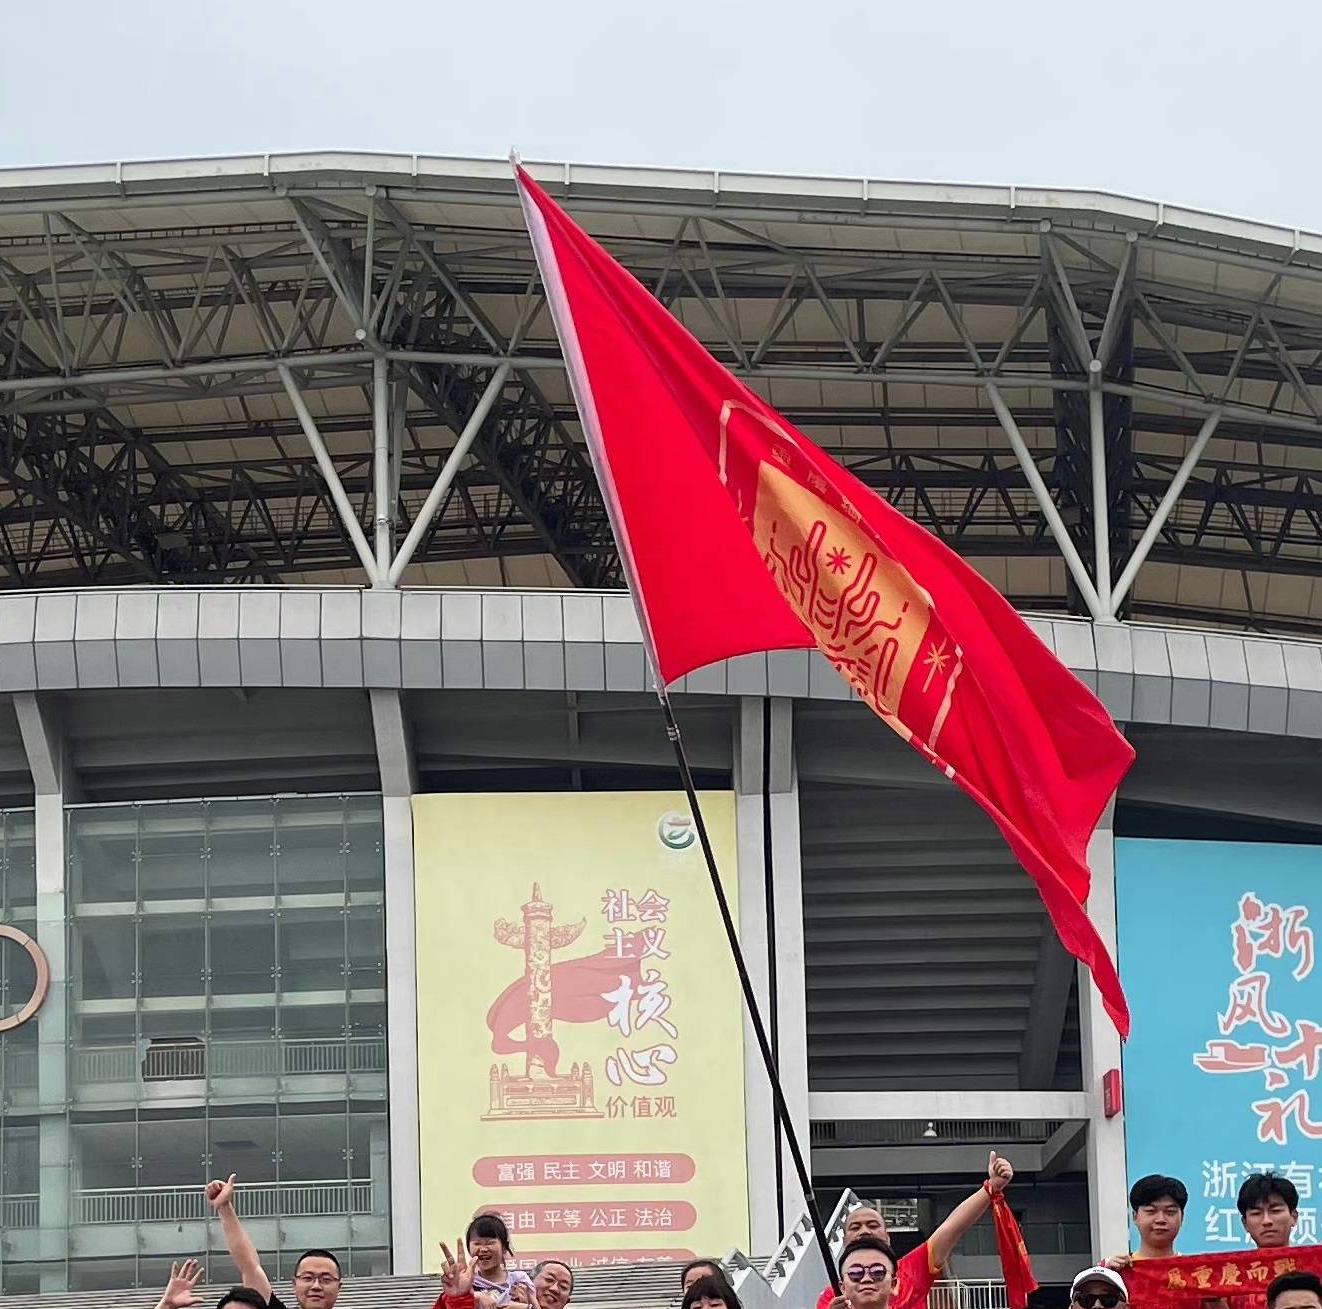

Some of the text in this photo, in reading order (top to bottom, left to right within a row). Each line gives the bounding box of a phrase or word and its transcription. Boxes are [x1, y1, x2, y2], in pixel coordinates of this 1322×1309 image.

[600, 888, 670, 923] 社会
[603, 927, 671, 961] 主义
[600, 969, 678, 1086] 核心
[605, 1095, 678, 1120] 价值观
[496, 1159, 672, 1182] 富强 民主 文明 和谐
[501, 1207, 673, 1230] 自由 平等 公正 法治
